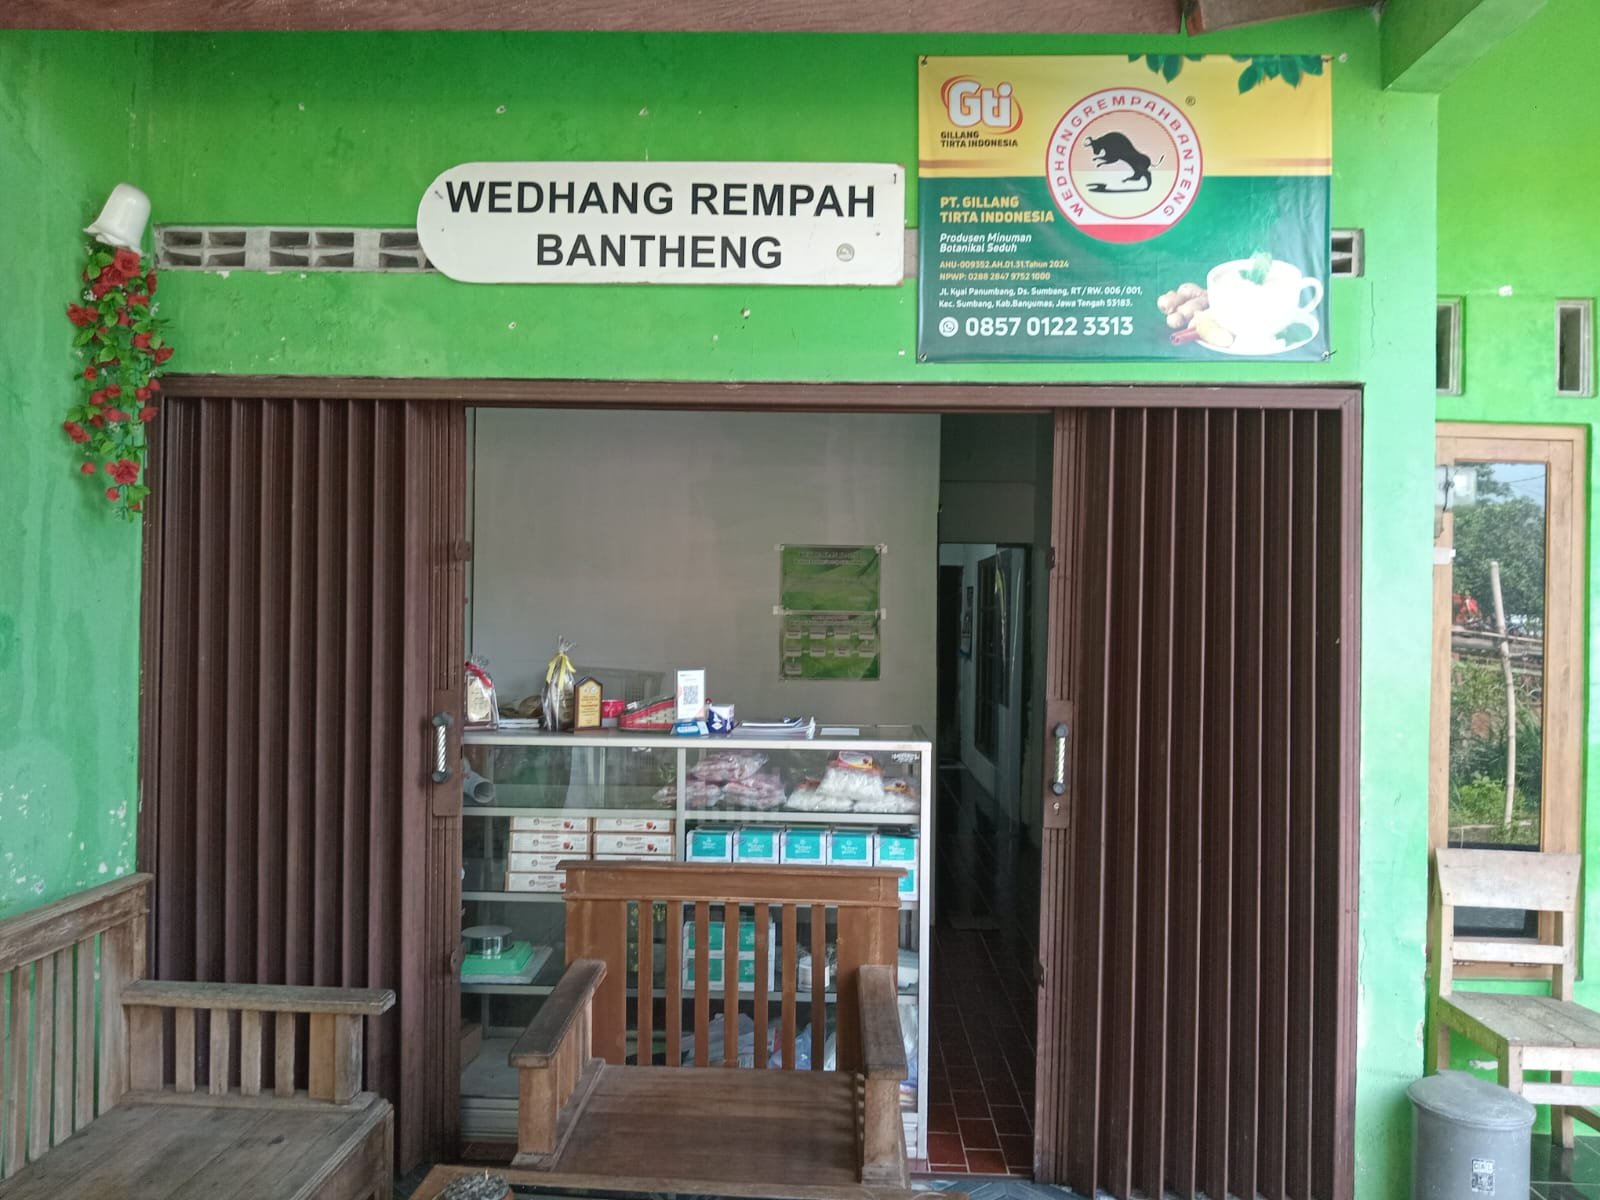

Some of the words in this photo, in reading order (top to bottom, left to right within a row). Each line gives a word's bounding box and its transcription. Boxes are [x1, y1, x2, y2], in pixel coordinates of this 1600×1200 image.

[948, 80, 1012, 128] Gti
[940, 131, 979, 139] GILLANG
[940, 139, 967, 148] TIRTA
[968, 139, 1018, 148] INDONESIA
[446, 181, 674, 215] WEDHANG
[691, 184, 876, 218] REMPAH
[940, 196, 960, 209] PT.
[962, 196, 1020, 209] GILLANG
[940, 211, 979, 223] TIRTA
[980, 210, 1055, 223] INDONESIA
[939, 233, 986, 243] Produsen
[987, 232, 1032, 243] Minuman
[537, 234, 783, 269] BANTHENG
[939, 243, 985, 253] Botanikal
[986, 243, 1017, 253] Seduh
[1049, 260, 1069, 269] 2024
[1010, 272, 1031, 281] 9752
[1031, 271, 1051, 281] 1000
[968, 287, 1016, 297] Panumbang,
[1031, 287, 1069, 297] Sumbang,
[938, 300, 955, 308] Kec.
[956, 299, 995, 309] Sumbang,
[1056, 299, 1076, 308] Jawa
[1077, 299, 1105, 309] Tengah
[965, 316, 1021, 337] 0857
[1026, 316, 1078, 336] 0122
[1082, 316, 1134, 336] 3313
